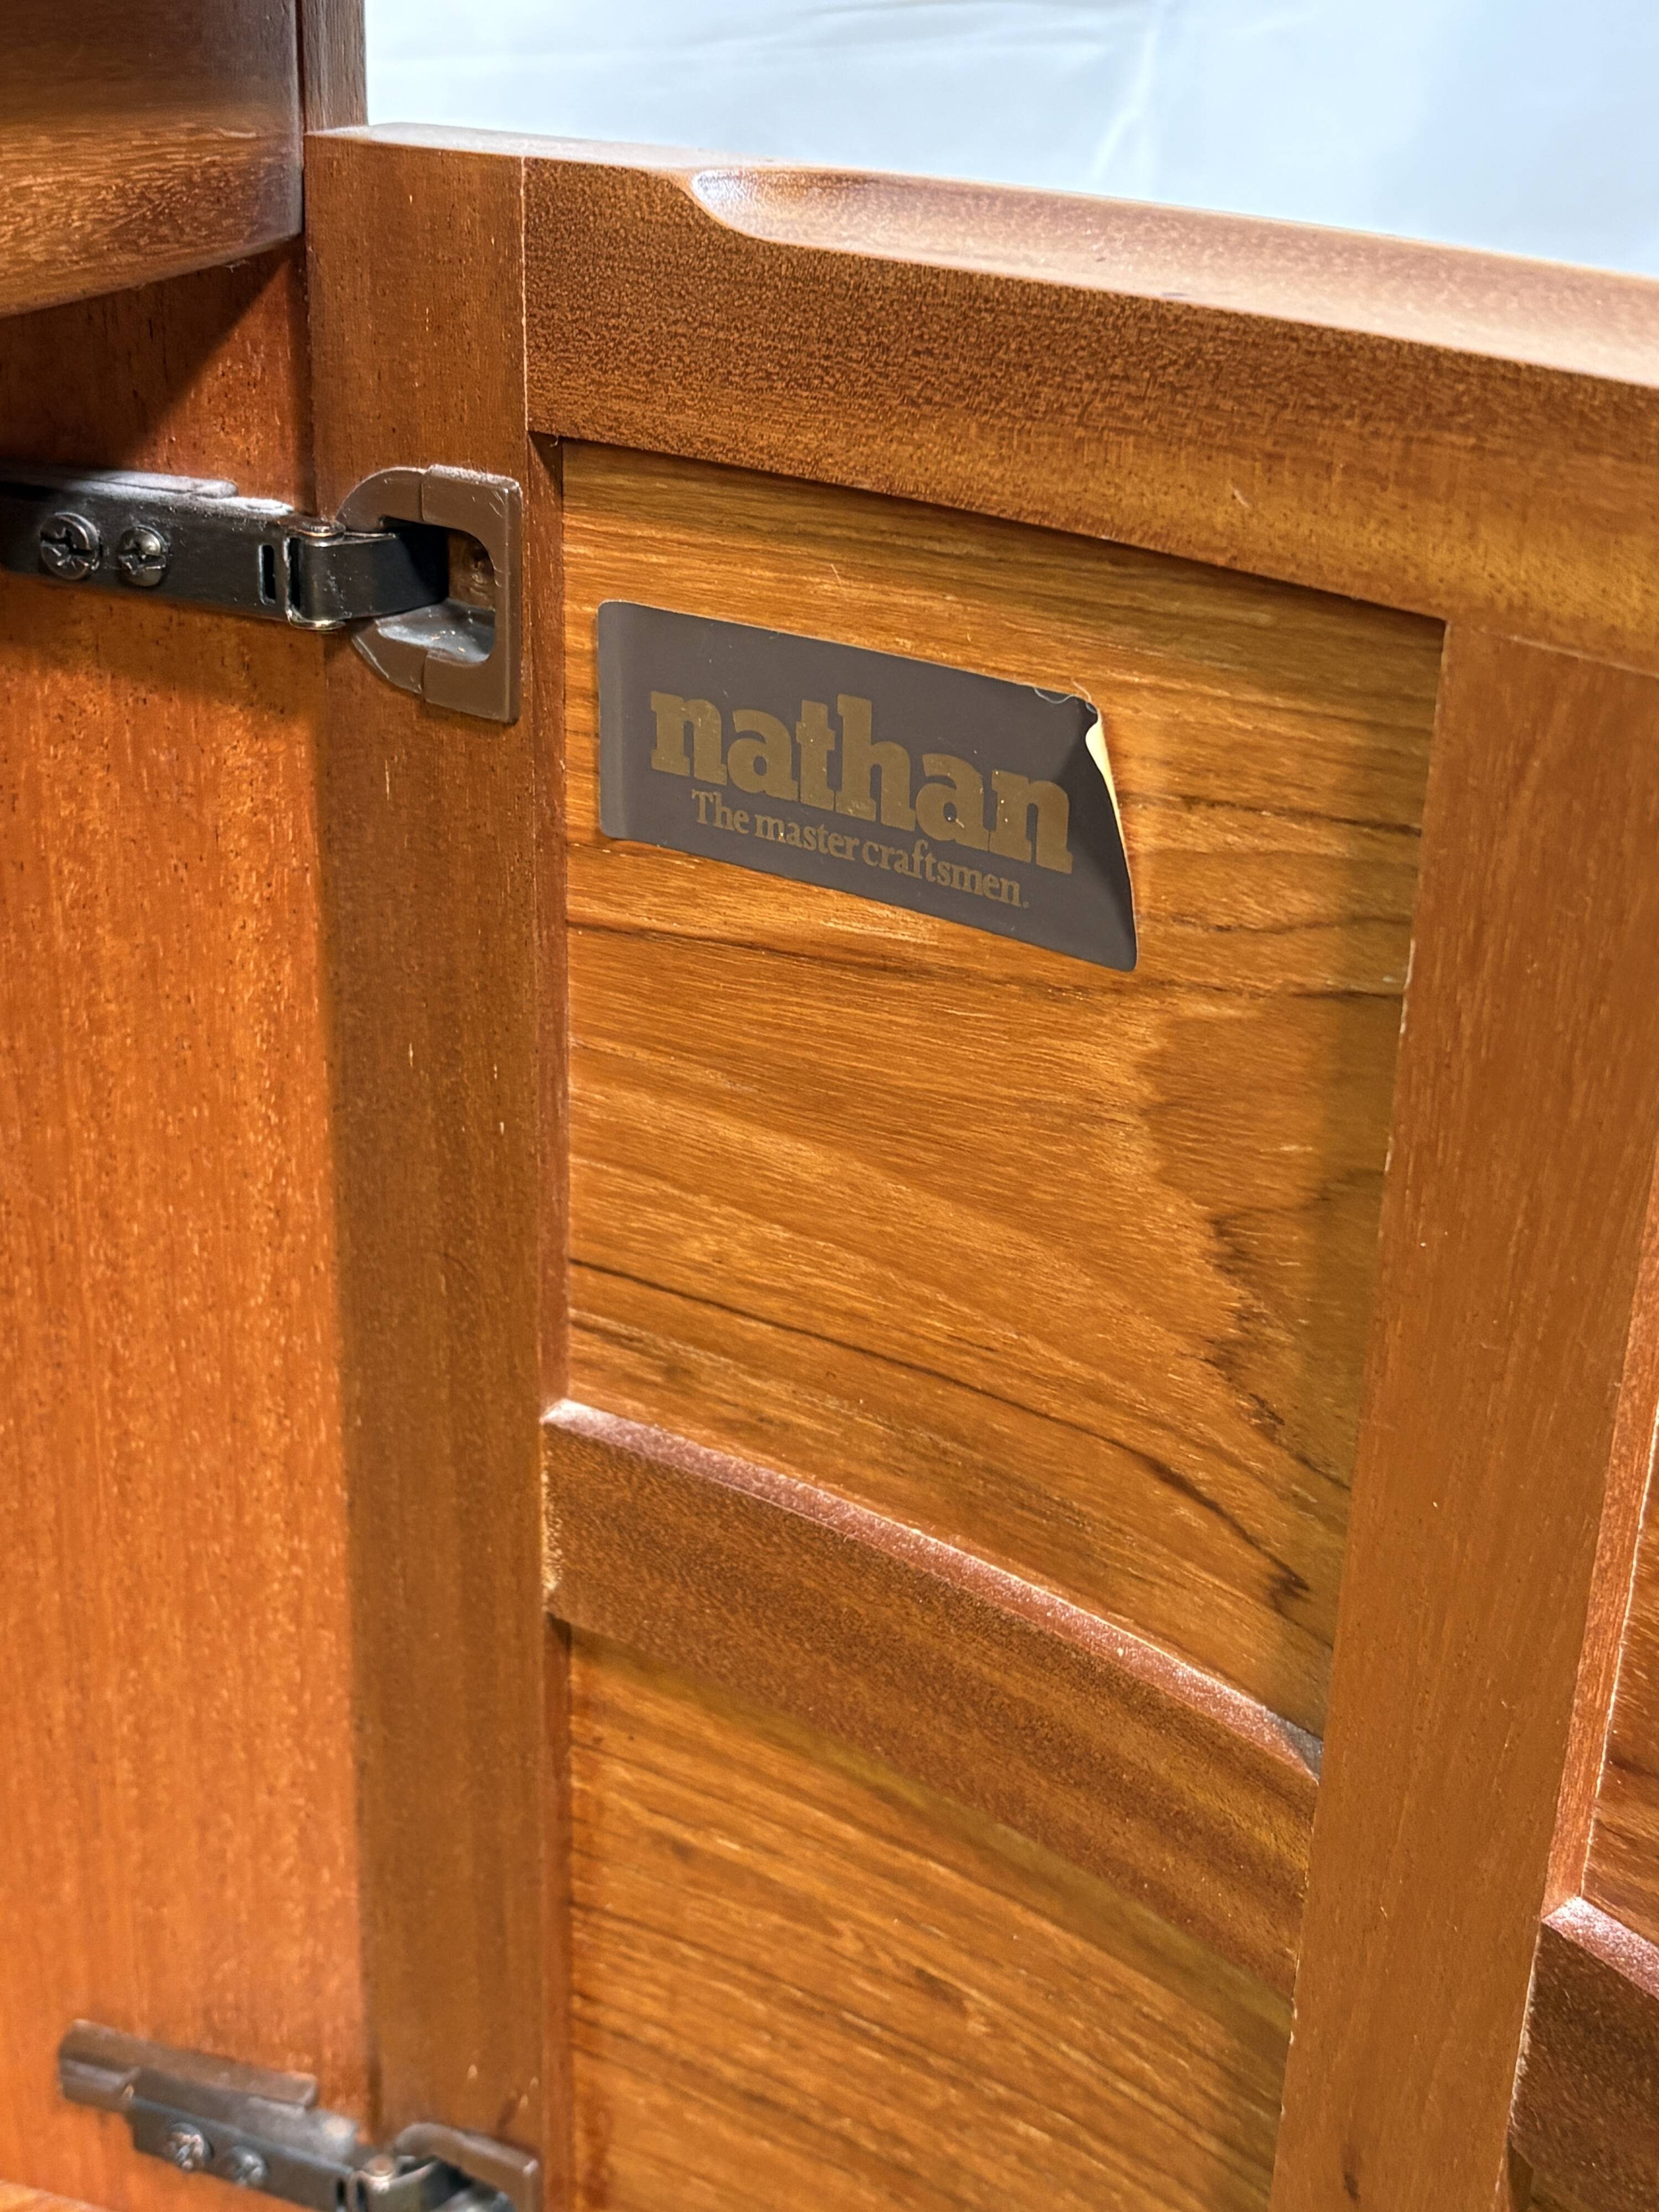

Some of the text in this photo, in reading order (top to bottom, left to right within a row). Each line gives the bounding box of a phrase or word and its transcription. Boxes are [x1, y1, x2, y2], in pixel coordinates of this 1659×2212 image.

[650, 691, 1073, 874] nathan
[691, 790, 1030, 909] The master craftsmen.
